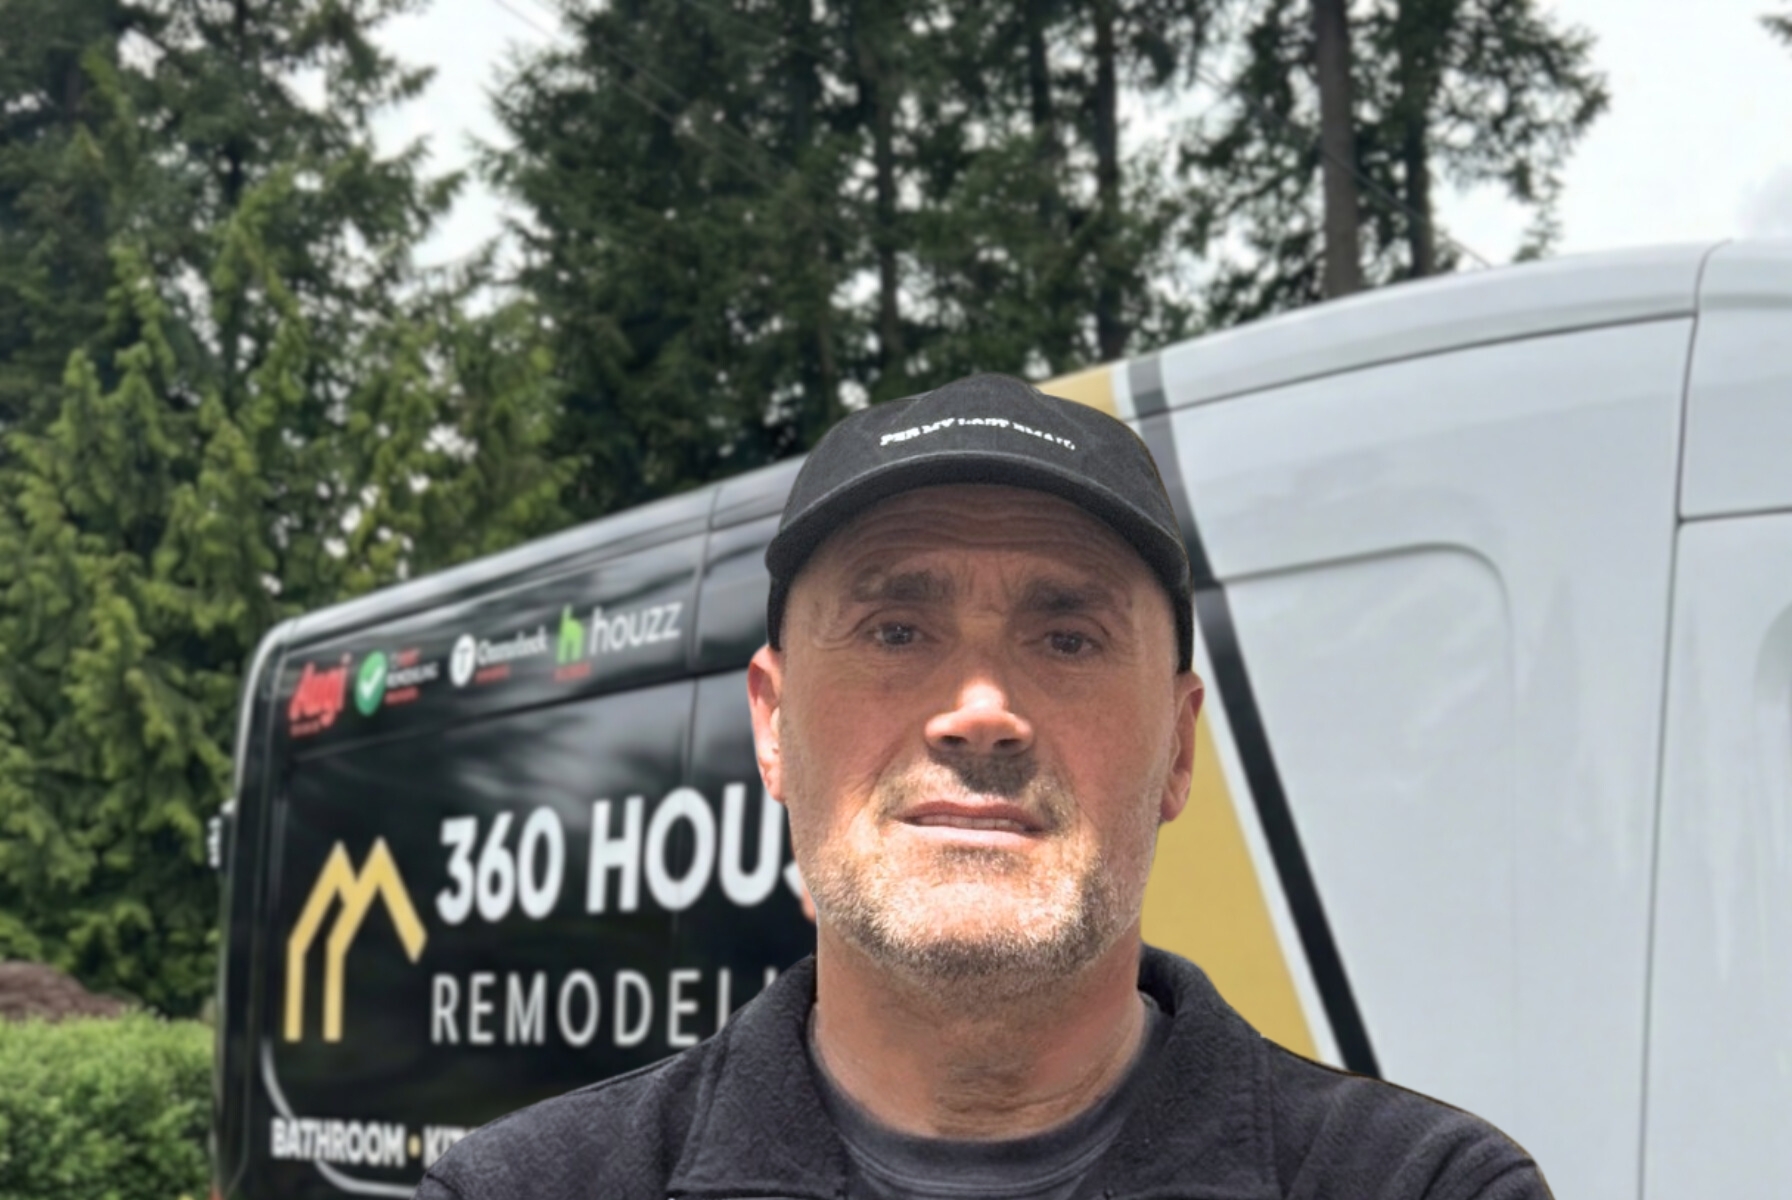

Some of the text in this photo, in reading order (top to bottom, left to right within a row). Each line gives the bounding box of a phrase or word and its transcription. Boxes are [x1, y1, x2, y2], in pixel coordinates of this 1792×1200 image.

[590, 602, 683, 656] houzz
[434, 783, 804, 926] 360 HOU
[431, 967, 778, 1047] REMODEL
[271, 1117, 406, 1169] BATHROOM
